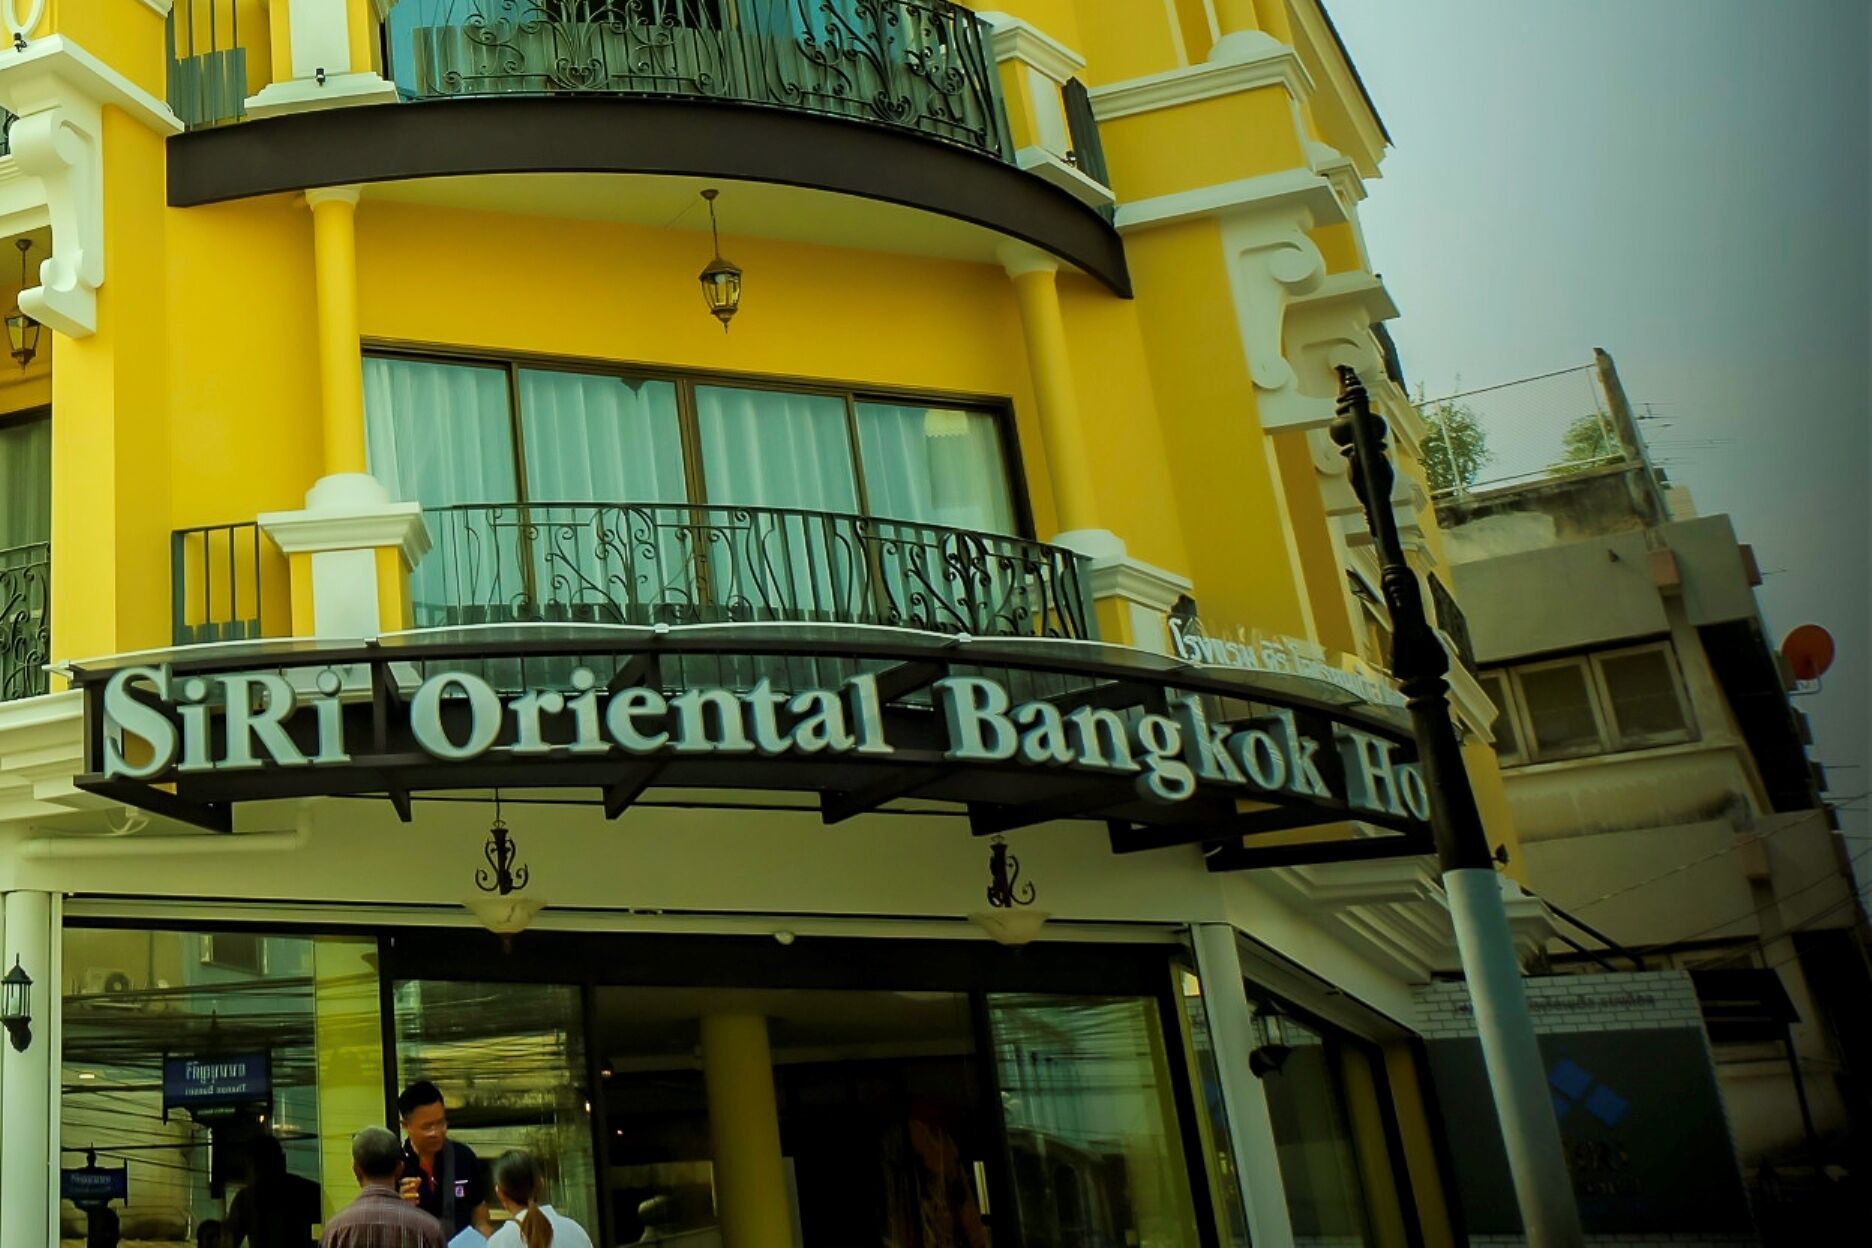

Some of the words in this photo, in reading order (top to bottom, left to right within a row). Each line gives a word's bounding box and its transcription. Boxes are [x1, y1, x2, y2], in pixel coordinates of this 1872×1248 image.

[103, 663, 352, 781] SiRi
[409, 666, 895, 761] Oriental
[932, 674, 1331, 803] Bangkok
[1335, 731, 1431, 822] Ho
